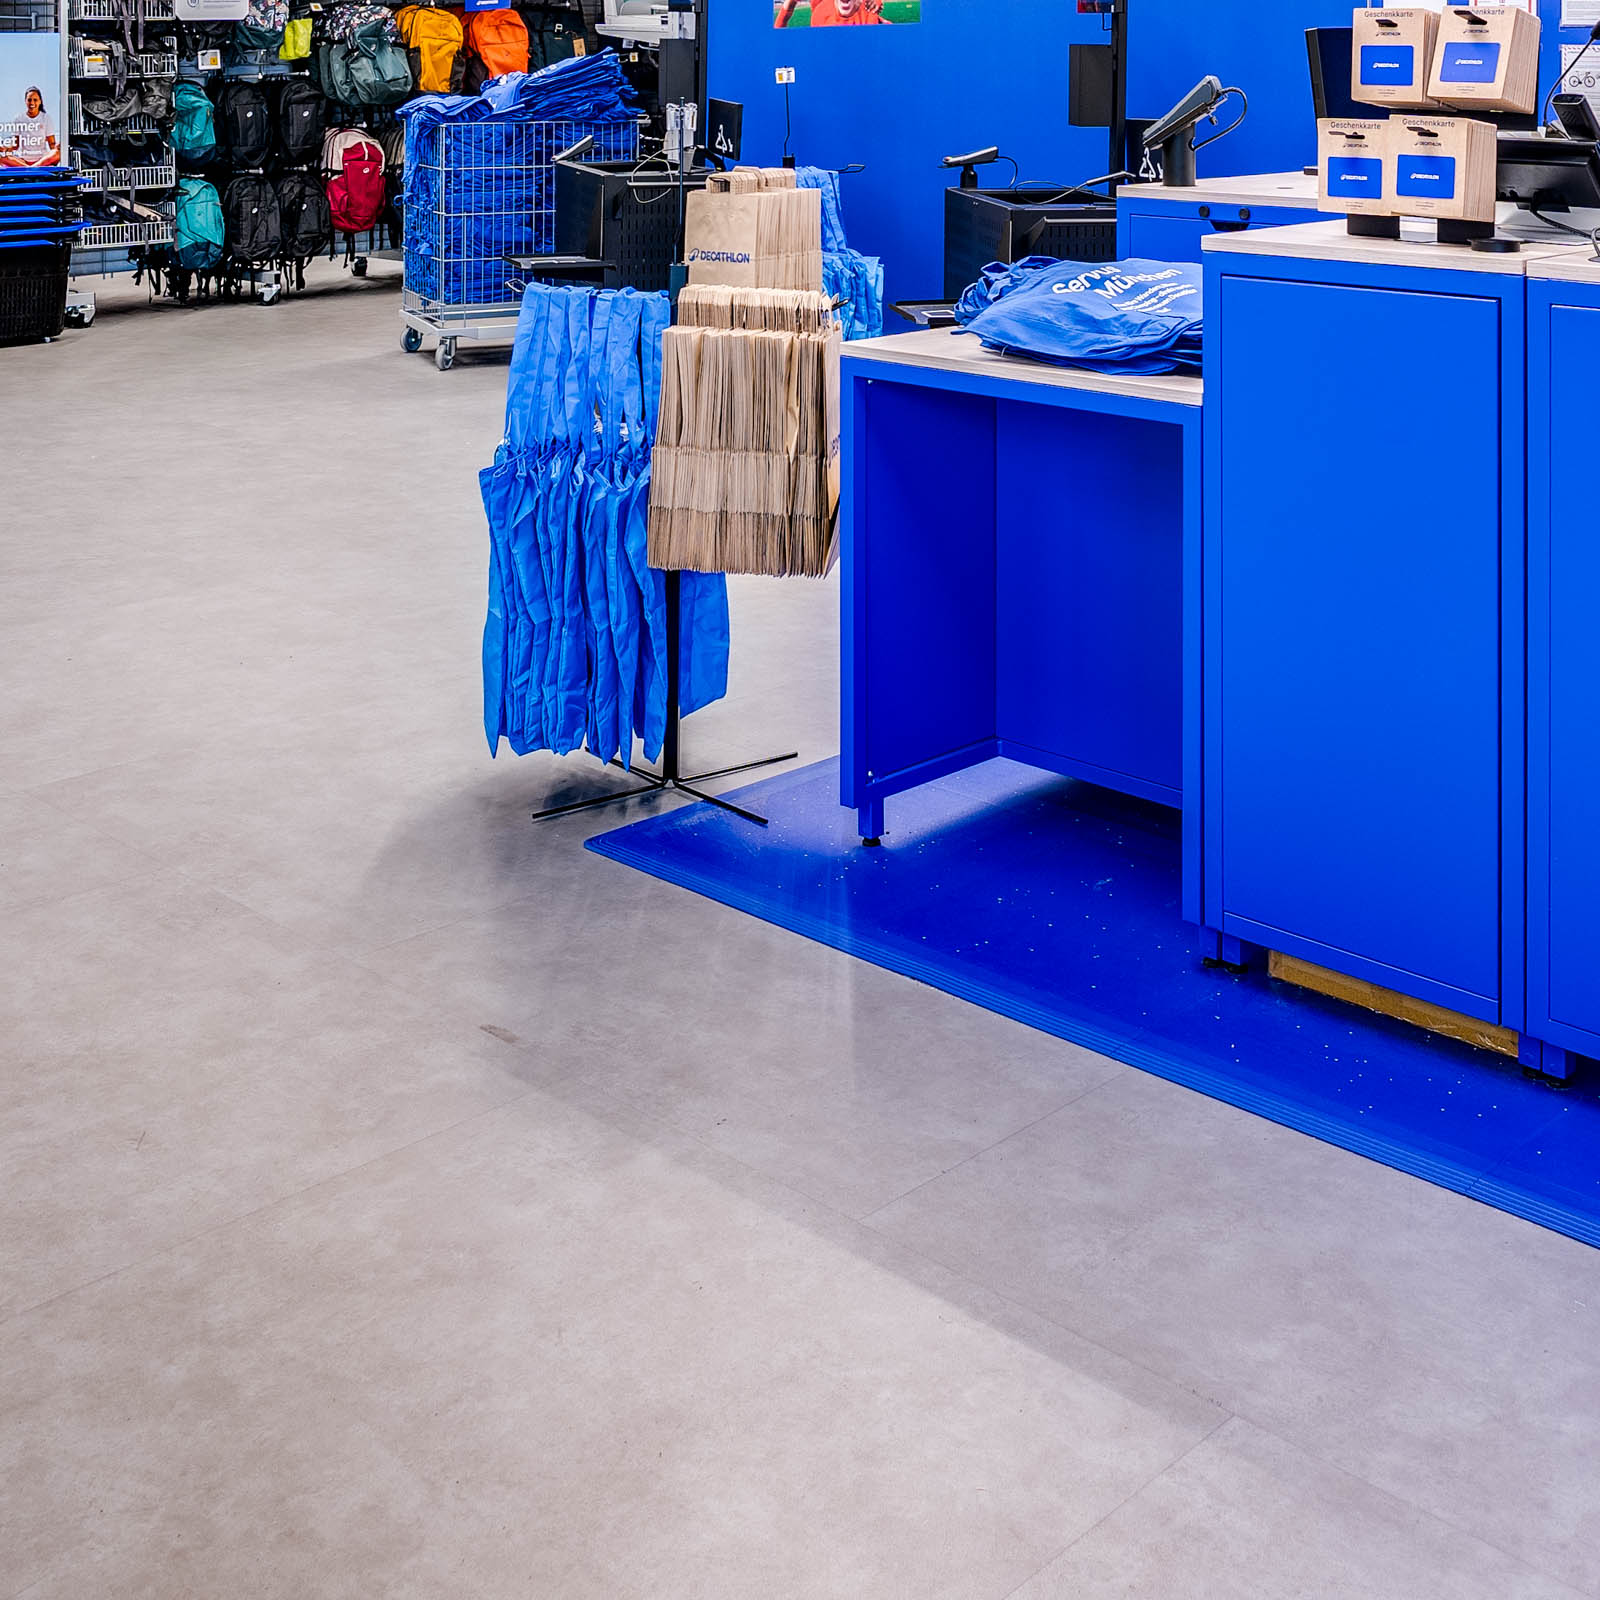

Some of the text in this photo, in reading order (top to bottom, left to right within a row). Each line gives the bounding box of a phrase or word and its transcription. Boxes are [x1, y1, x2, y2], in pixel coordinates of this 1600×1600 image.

[1364, 10, 1414, 18] Geschenkkarte
[1330, 121, 1381, 130] Geschenkkarte
[1402, 118, 1456, 128] Geschenkkarte
[18, 134, 44, 147] hier
[700, 250, 750, 264] DECATHLON
[1093, 267, 1184, 300] München
